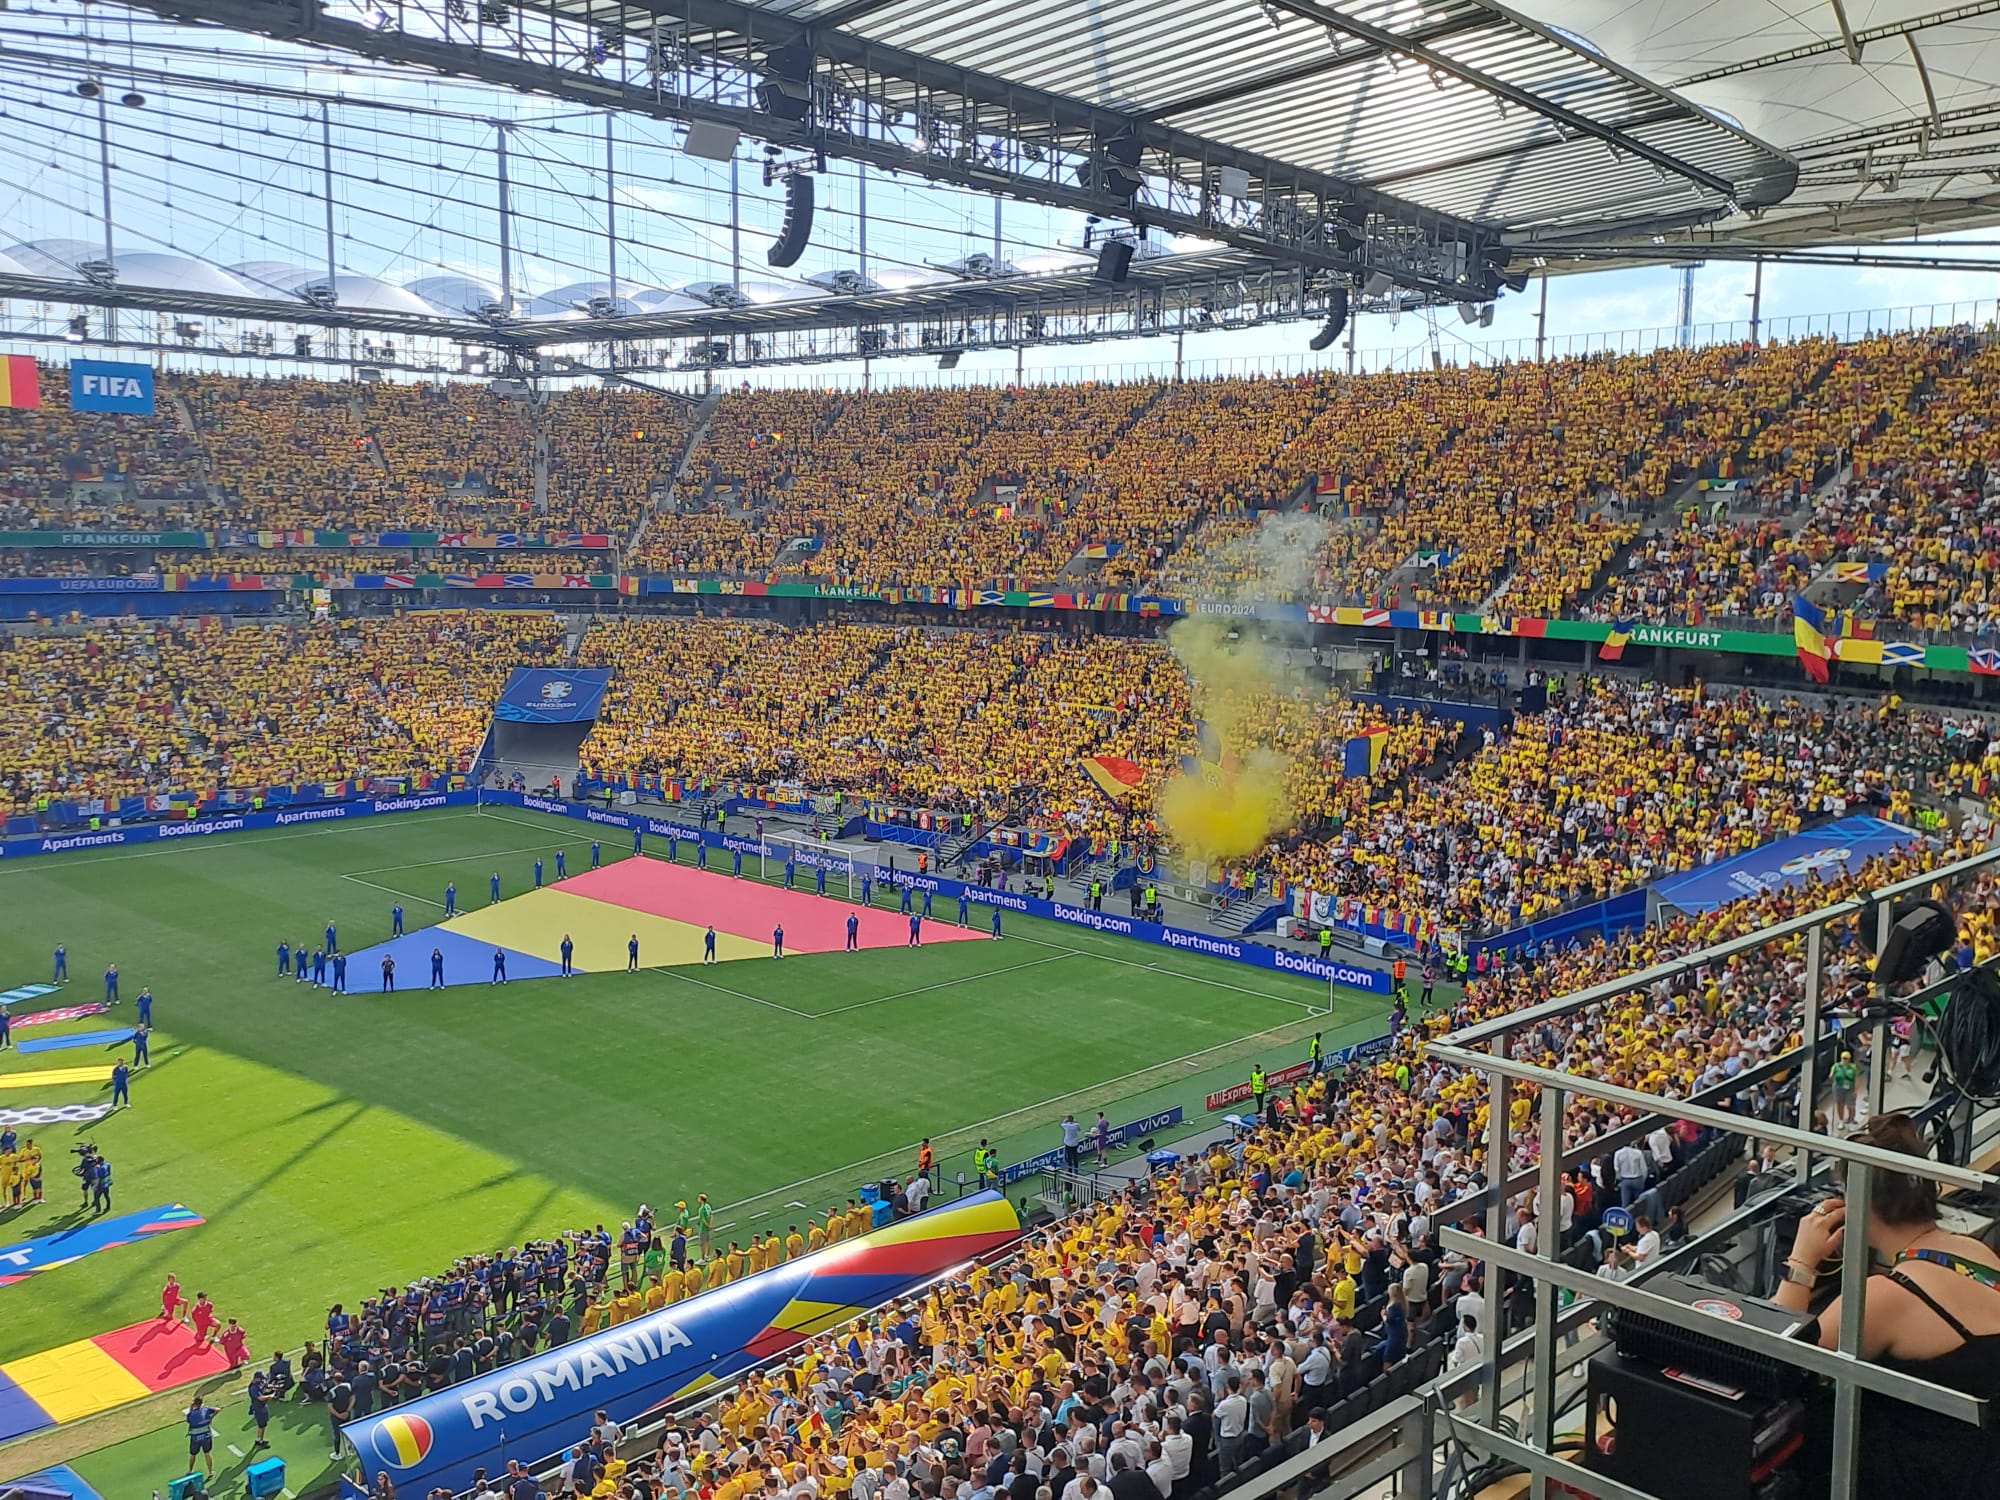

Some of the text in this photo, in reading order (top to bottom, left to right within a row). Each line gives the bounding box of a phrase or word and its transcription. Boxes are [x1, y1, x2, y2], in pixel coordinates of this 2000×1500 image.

[83, 375, 144, 399] FIFA
[62, 534, 162, 544] FRANKFURT
[1630, 629, 1721, 646] RANKFURT
[374, 795, 446, 812] Booking.com
[523, 795, 567, 814] Booking.com
[275, 806, 345, 825] Apartments
[586, 809, 629, 826] Apartments
[159, 818, 243, 837] Booking.com
[649, 820, 699, 841] Booking.com
[42, 831, 125, 852] Apartments
[722, 836, 773, 857] Apartments
[964, 885, 1027, 911] Apartments
[1054, 903, 1132, 934] Booking.com
[1162, 928, 1241, 958] Apartments
[1275, 951, 1373, 987] Booking.com
[1139, 1114, 1170, 1132] vivo
[462, 1322, 693, 1430] ROMANIA
